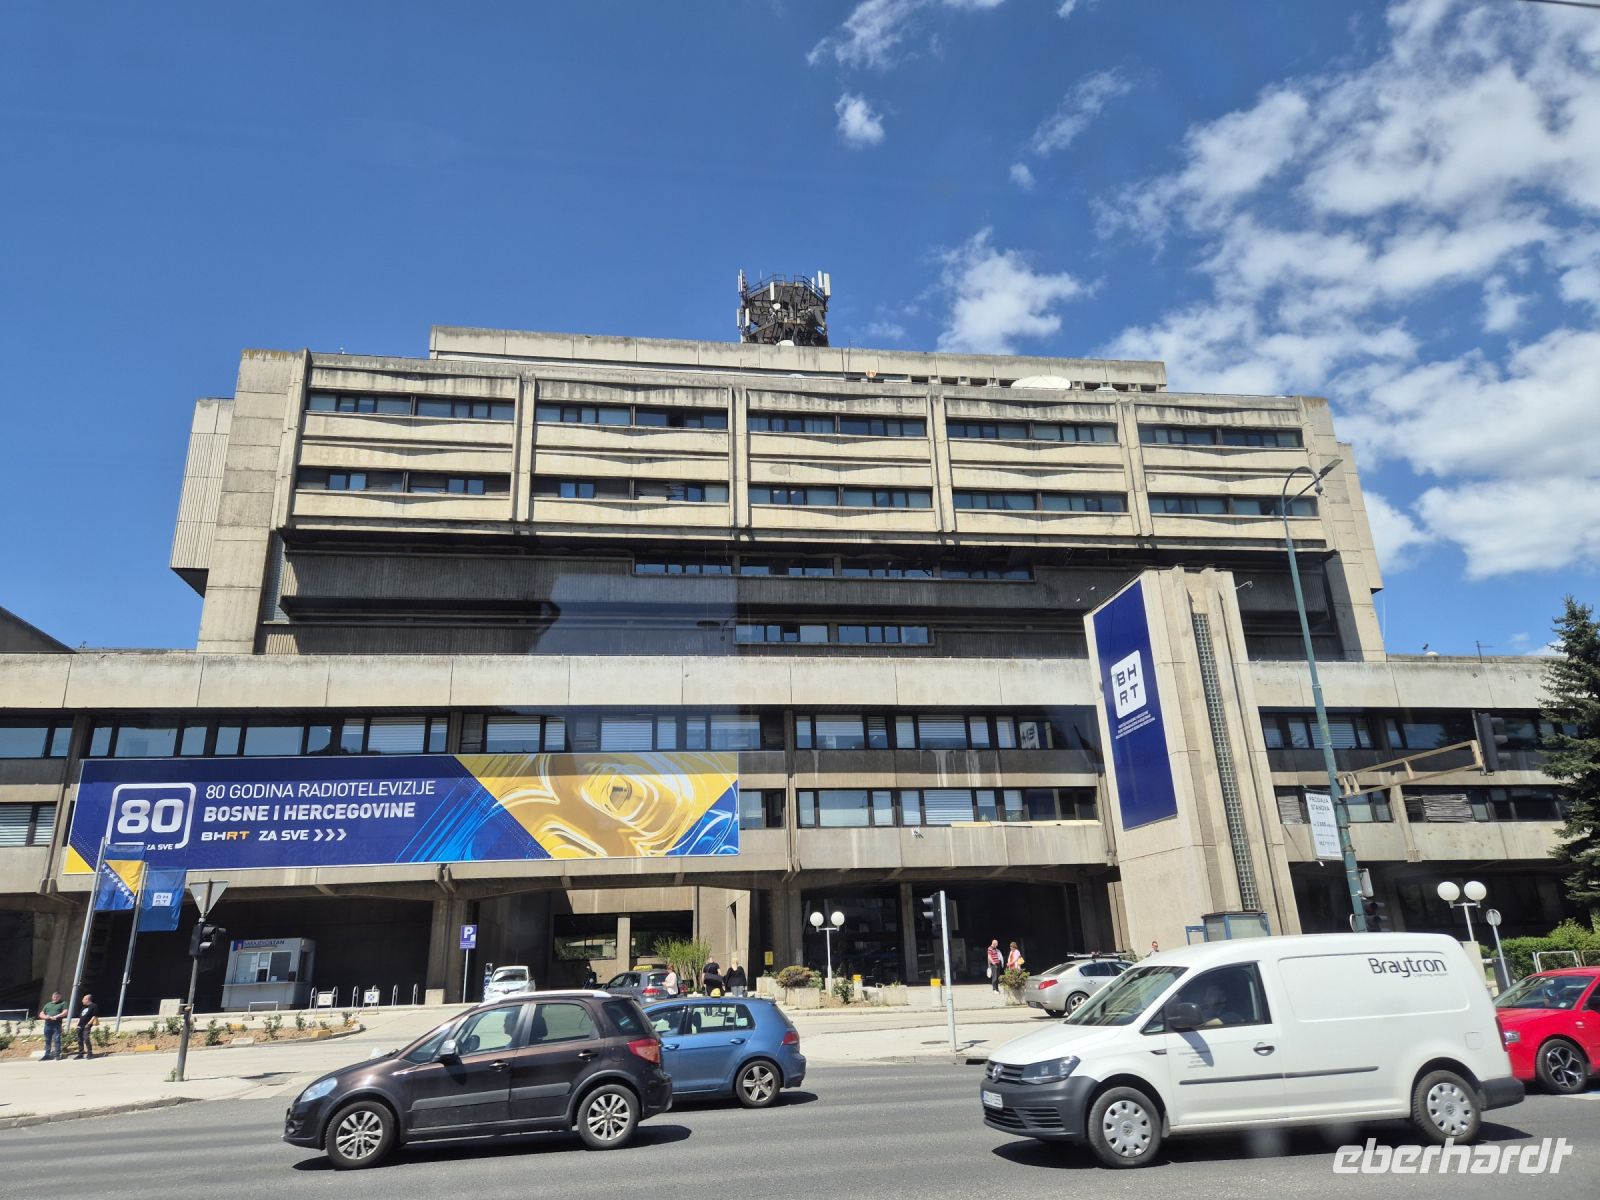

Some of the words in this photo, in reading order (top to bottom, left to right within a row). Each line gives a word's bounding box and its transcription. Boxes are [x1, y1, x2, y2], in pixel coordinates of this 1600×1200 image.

[1117, 663, 1137, 687] BH
[1119, 683, 1139, 707] RT
[205, 784, 226, 799] 80
[229, 783, 294, 799] GODINA
[298, 780, 436, 797] RADIOTELEVIZIJE
[117, 798, 184, 834] 80
[203, 805, 270, 822] BOSNE
[273, 805, 280, 821] I
[283, 802, 416, 820] HERCEGOVINE
[201, 831, 250, 841] BHRT
[258, 830, 277, 841] ZA
[280, 829, 310, 840] SVE
[146, 843, 156, 851] ZA
[157, 843, 174, 851] SVE
[463, 926, 474, 939] P
[1368, 956, 1448, 978] Braytron
